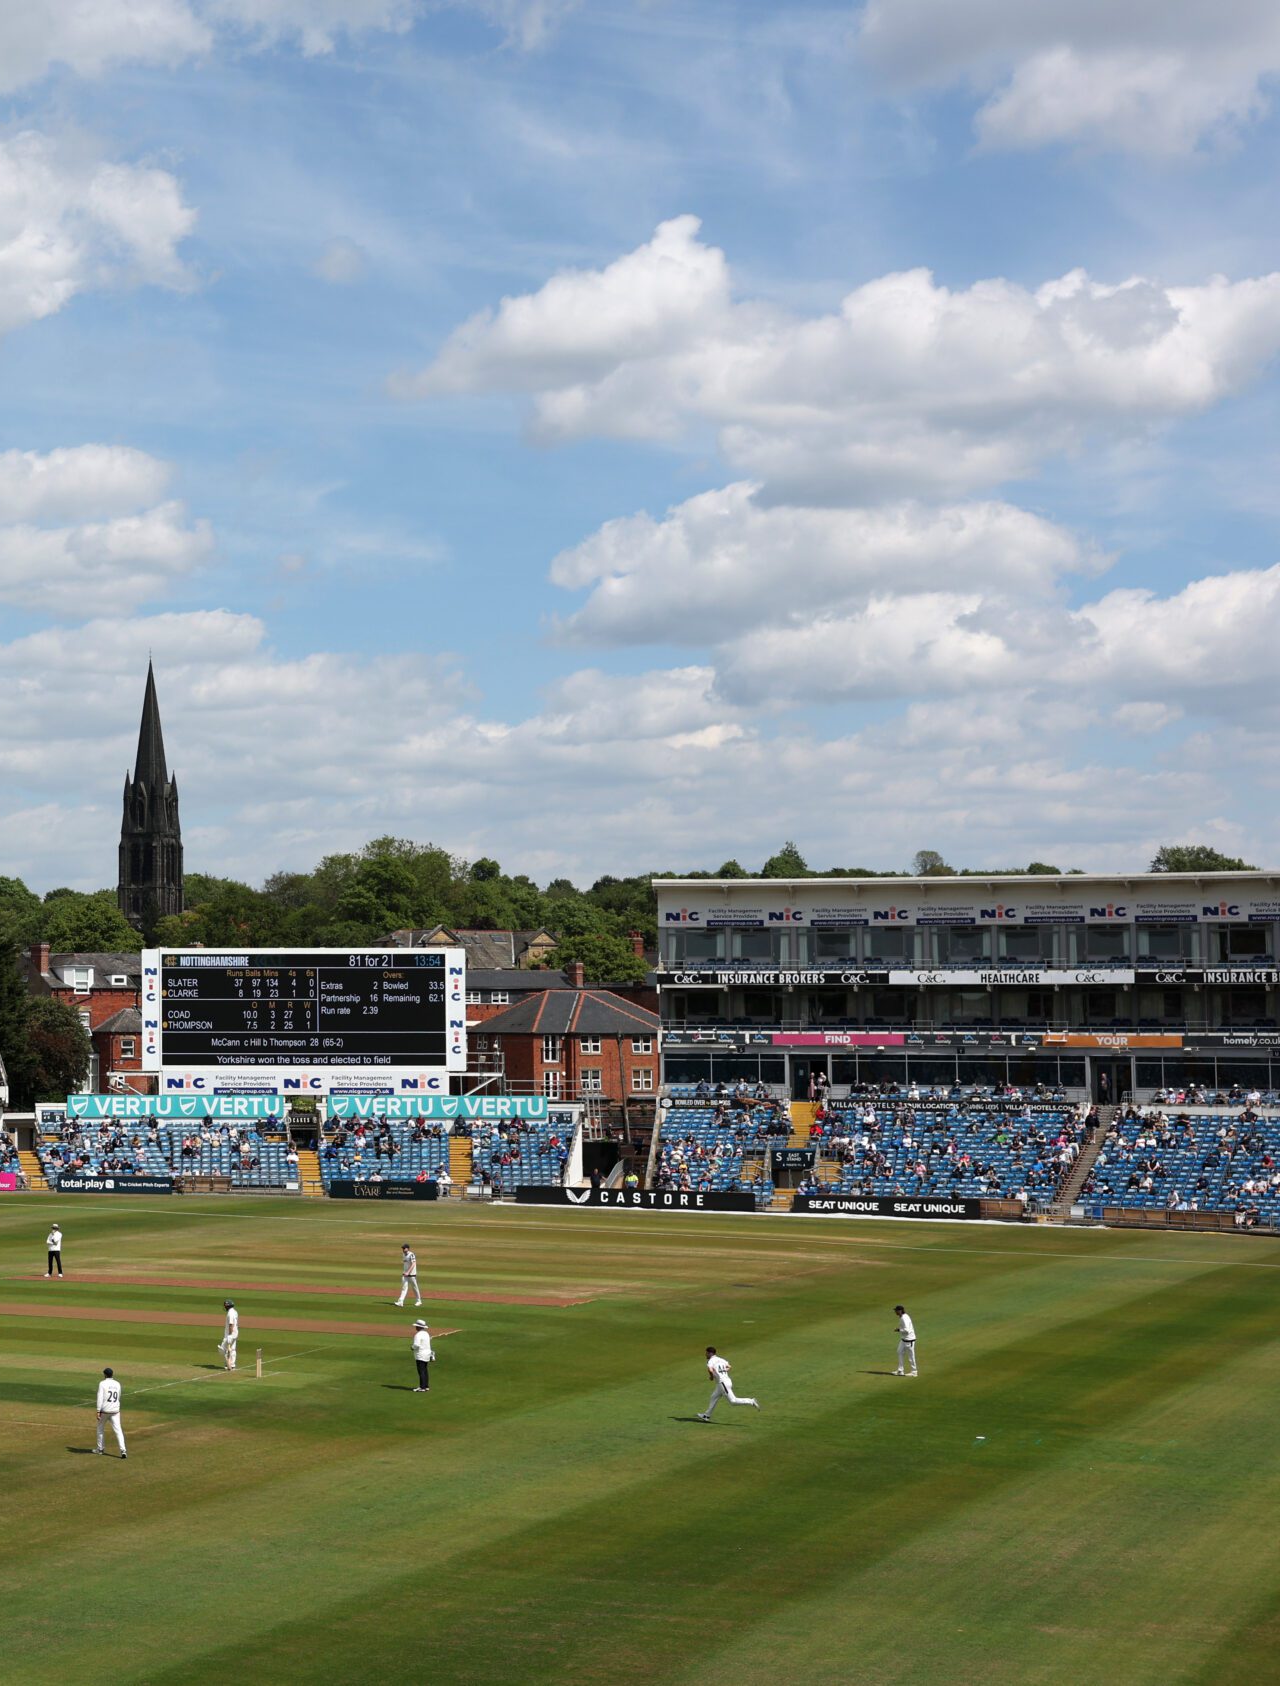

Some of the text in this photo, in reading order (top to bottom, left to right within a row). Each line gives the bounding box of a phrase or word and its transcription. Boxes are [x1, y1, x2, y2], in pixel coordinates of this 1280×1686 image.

[180, 956, 249, 966] NOTTINGHAMSHIRE
[349, 955, 388, 967] 81 for 2
[414, 956, 441, 966] 13:54
[226, 969, 314, 977] Runs Balls Mins 4s 6s
[980, 973, 1040, 983] HEALTHCARE
[1203, 972, 1267, 983] INSURANCE
[167, 978, 314, 987] SLATER 37 97 134 4 0
[717, 973, 825, 984] INSURANCE BROKERS
[320, 981, 444, 990] Extras 2 Bowled 33.5
[167, 989, 314, 998] CLARKE 8 19 23 1 0
[320, 993, 444, 1004] Partnership 16 Remaining 62.1
[269, 1001, 276, 1009] M
[287, 1001, 293, 1009] R
[303, 1001, 311, 1009] W
[167, 1010, 311, 1019] COAD 10.0 3 27 0
[321, 1006, 379, 1015] Run rate 2.39
[168, 1021, 311, 1030] THOMPSON 7.5 2 25 1
[211, 1038, 240, 1047] McCann
[250, 1038, 261, 1047] Hill
[263, 1038, 268, 1047] b
[270, 1038, 306, 1049] Thompson
[310, 1038, 319, 1047] 28
[322, 1038, 344, 1048] (65-2)
[824, 1035, 851, 1043] FIND
[1096, 1037, 1128, 1046] YOUR
[216, 1055, 255, 1064] Yorkshire
[277, 1056, 291, 1064] the
[292, 1056, 310, 1064] toss
[312, 1056, 328, 1064] and
[330, 1056, 361, 1064] elected
[373, 1056, 391, 1064] field
[93, 1097, 172, 1116] VERTU
[202, 1096, 280, 1116] VERTU
[354, 1097, 433, 1116] VERTU
[463, 1097, 543, 1116] VERTU
[775, 1152, 783, 1162] S
[805, 1152, 813, 1162] T
[60, 1178, 104, 1190] total-play
[600, 1191, 704, 1206] CASTORE
[808, 1200, 879, 1211] SEAT UNIQUE
[893, 1203, 966, 1214] SEAT UNIQUE
[107, 1390, 118, 1403] 29
